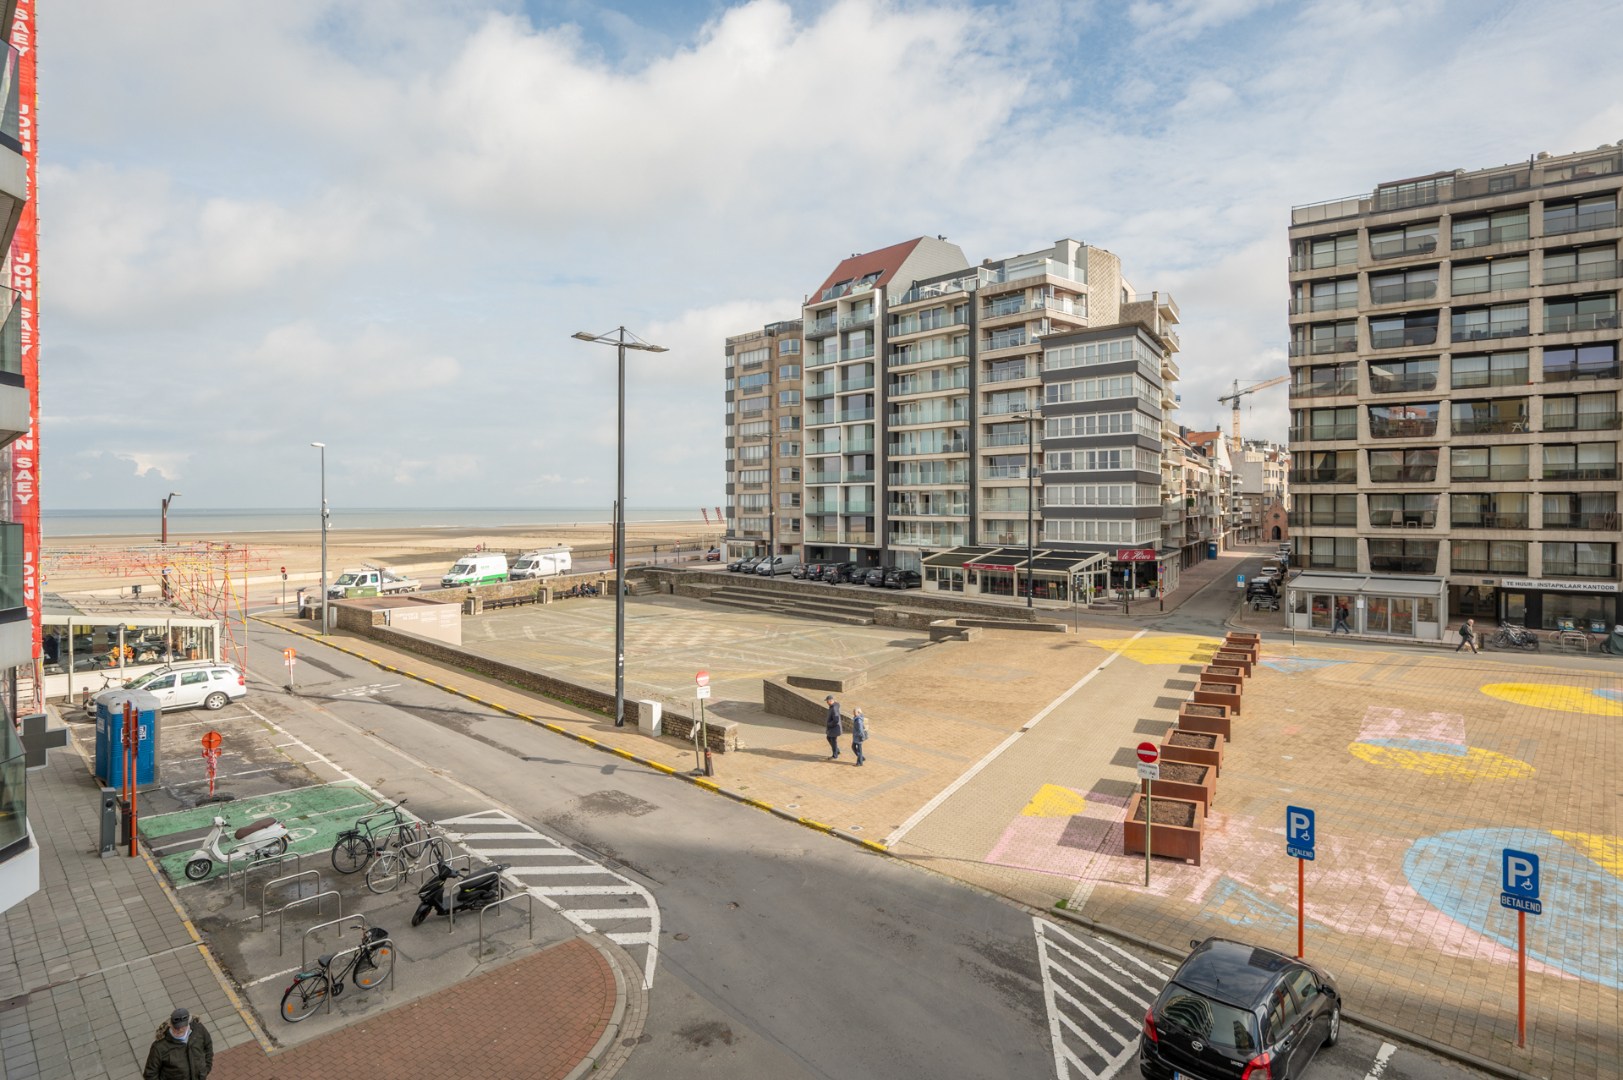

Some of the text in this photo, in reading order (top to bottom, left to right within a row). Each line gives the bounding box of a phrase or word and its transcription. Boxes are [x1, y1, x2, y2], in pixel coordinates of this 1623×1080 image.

[12, 8, 30, 57] SAEY
[14, 252, 33, 300] JOHN
[16, 457, 34, 505] SAEY
[1290, 812, 1310, 839] P
[1507, 856, 1533, 887] P
[1501, 895, 1541, 912] BETALEND
